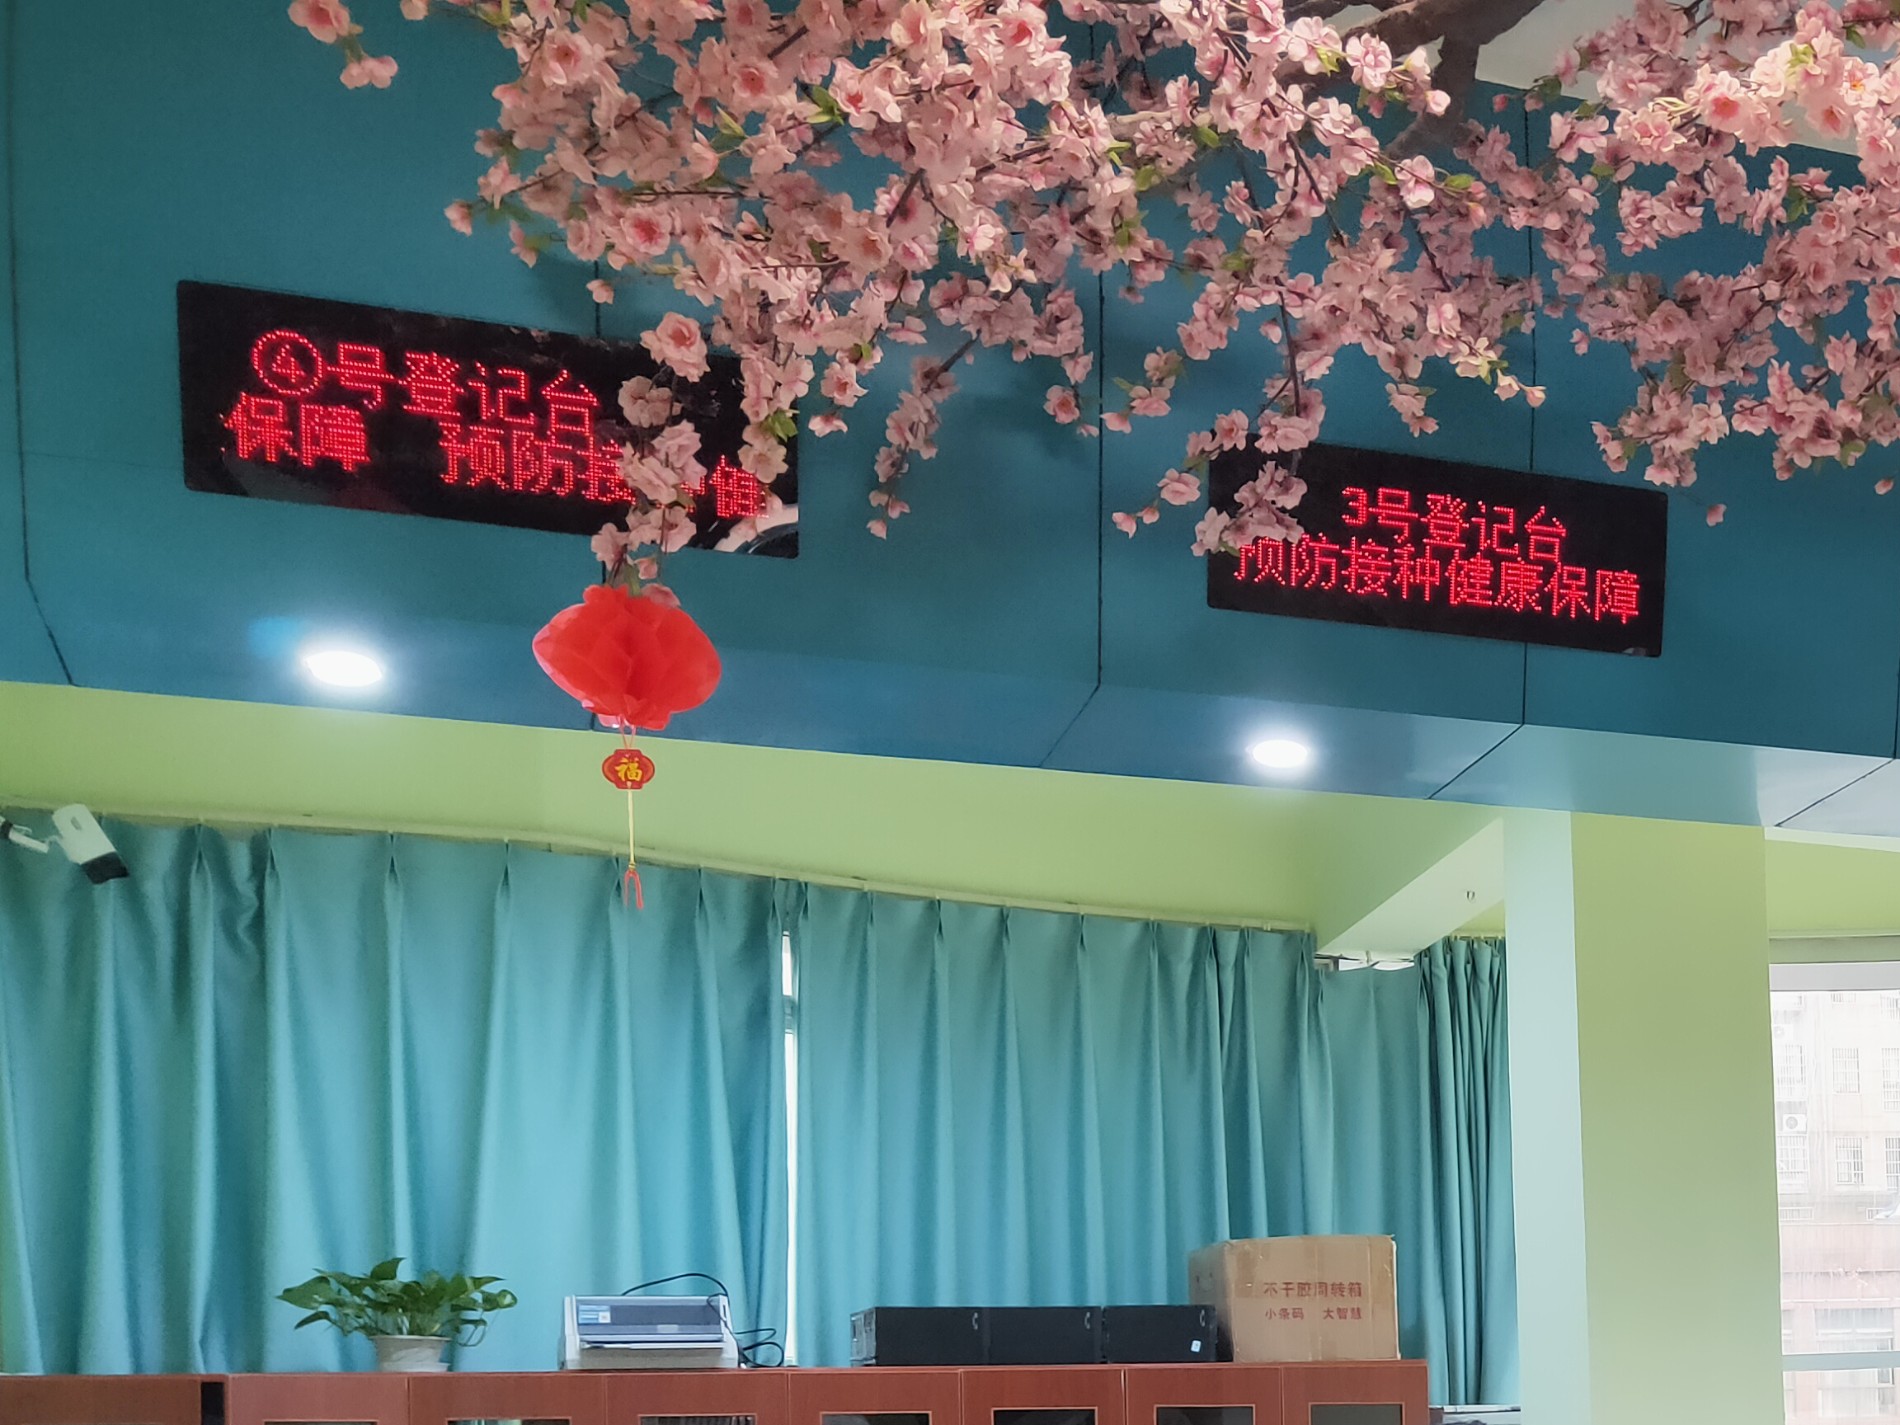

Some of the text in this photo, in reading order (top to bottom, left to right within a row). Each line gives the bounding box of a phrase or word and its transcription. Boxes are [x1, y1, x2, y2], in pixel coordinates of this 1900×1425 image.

[220, 392, 371, 472] 保障
[1341, 486, 1568, 565] 3号登记台
[1232, 532, 1642, 624] 预防接种健康保障
[614, 756, 643, 782] 福
[1263, 1281, 1363, 1298] 不干胶周转箱
